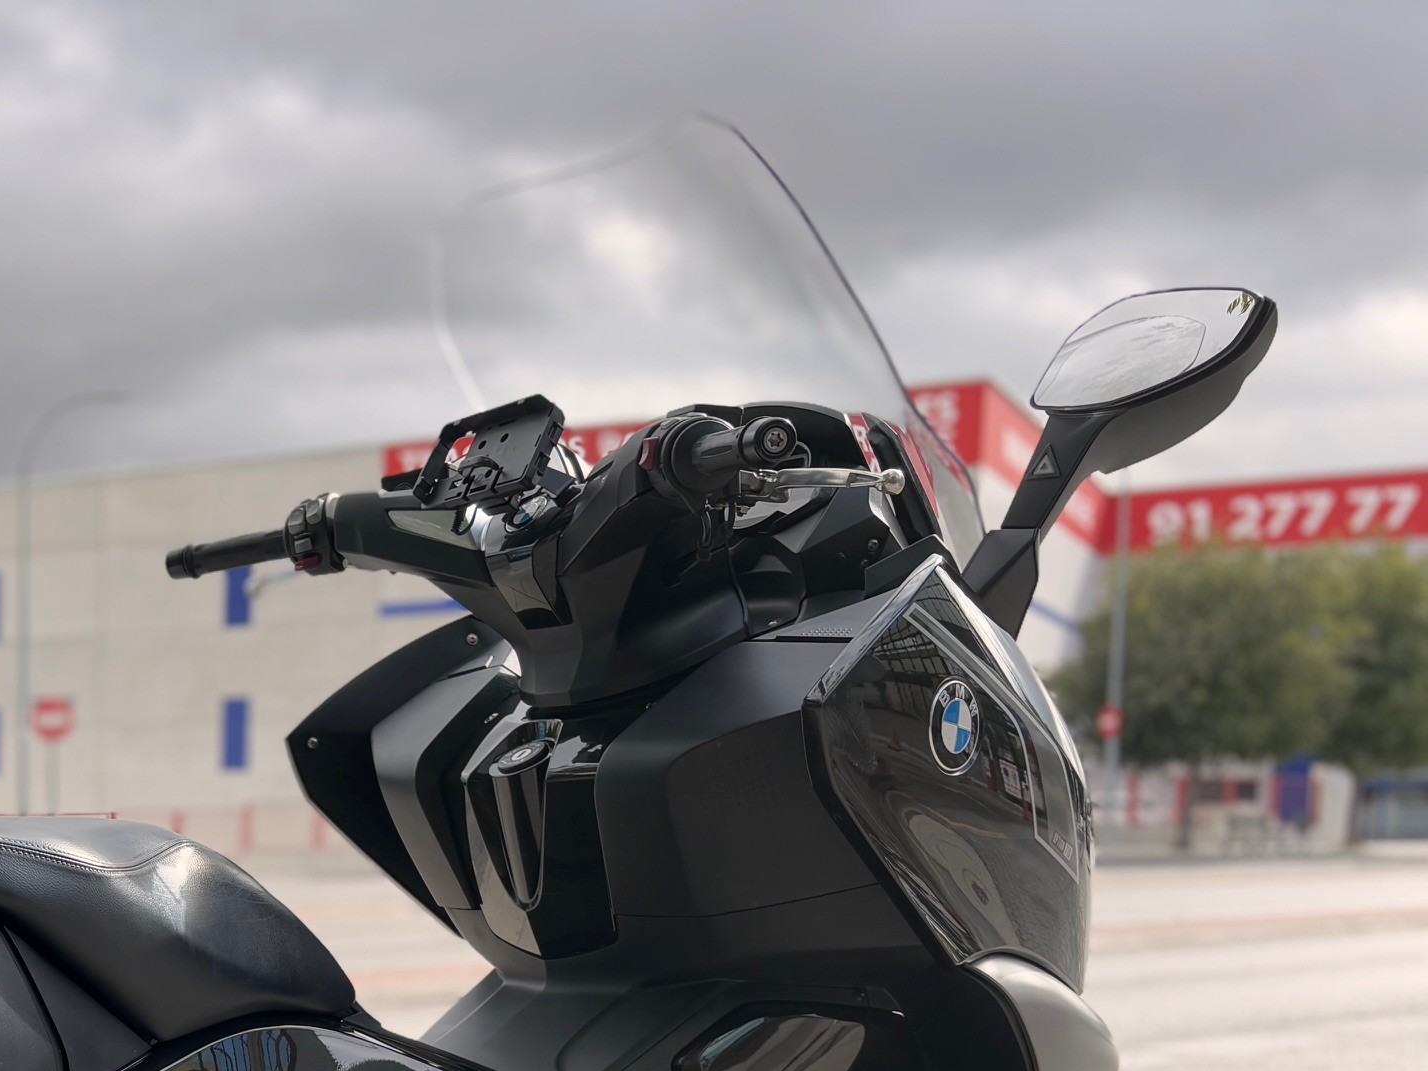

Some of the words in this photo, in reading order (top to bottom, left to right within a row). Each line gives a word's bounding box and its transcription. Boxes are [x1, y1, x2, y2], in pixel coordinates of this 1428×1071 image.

[1147, 500, 1212, 543] 91
[1228, 488, 1335, 541] 277
[1346, 483, 1421, 534] 77
[938, 683, 979, 718] BMW
